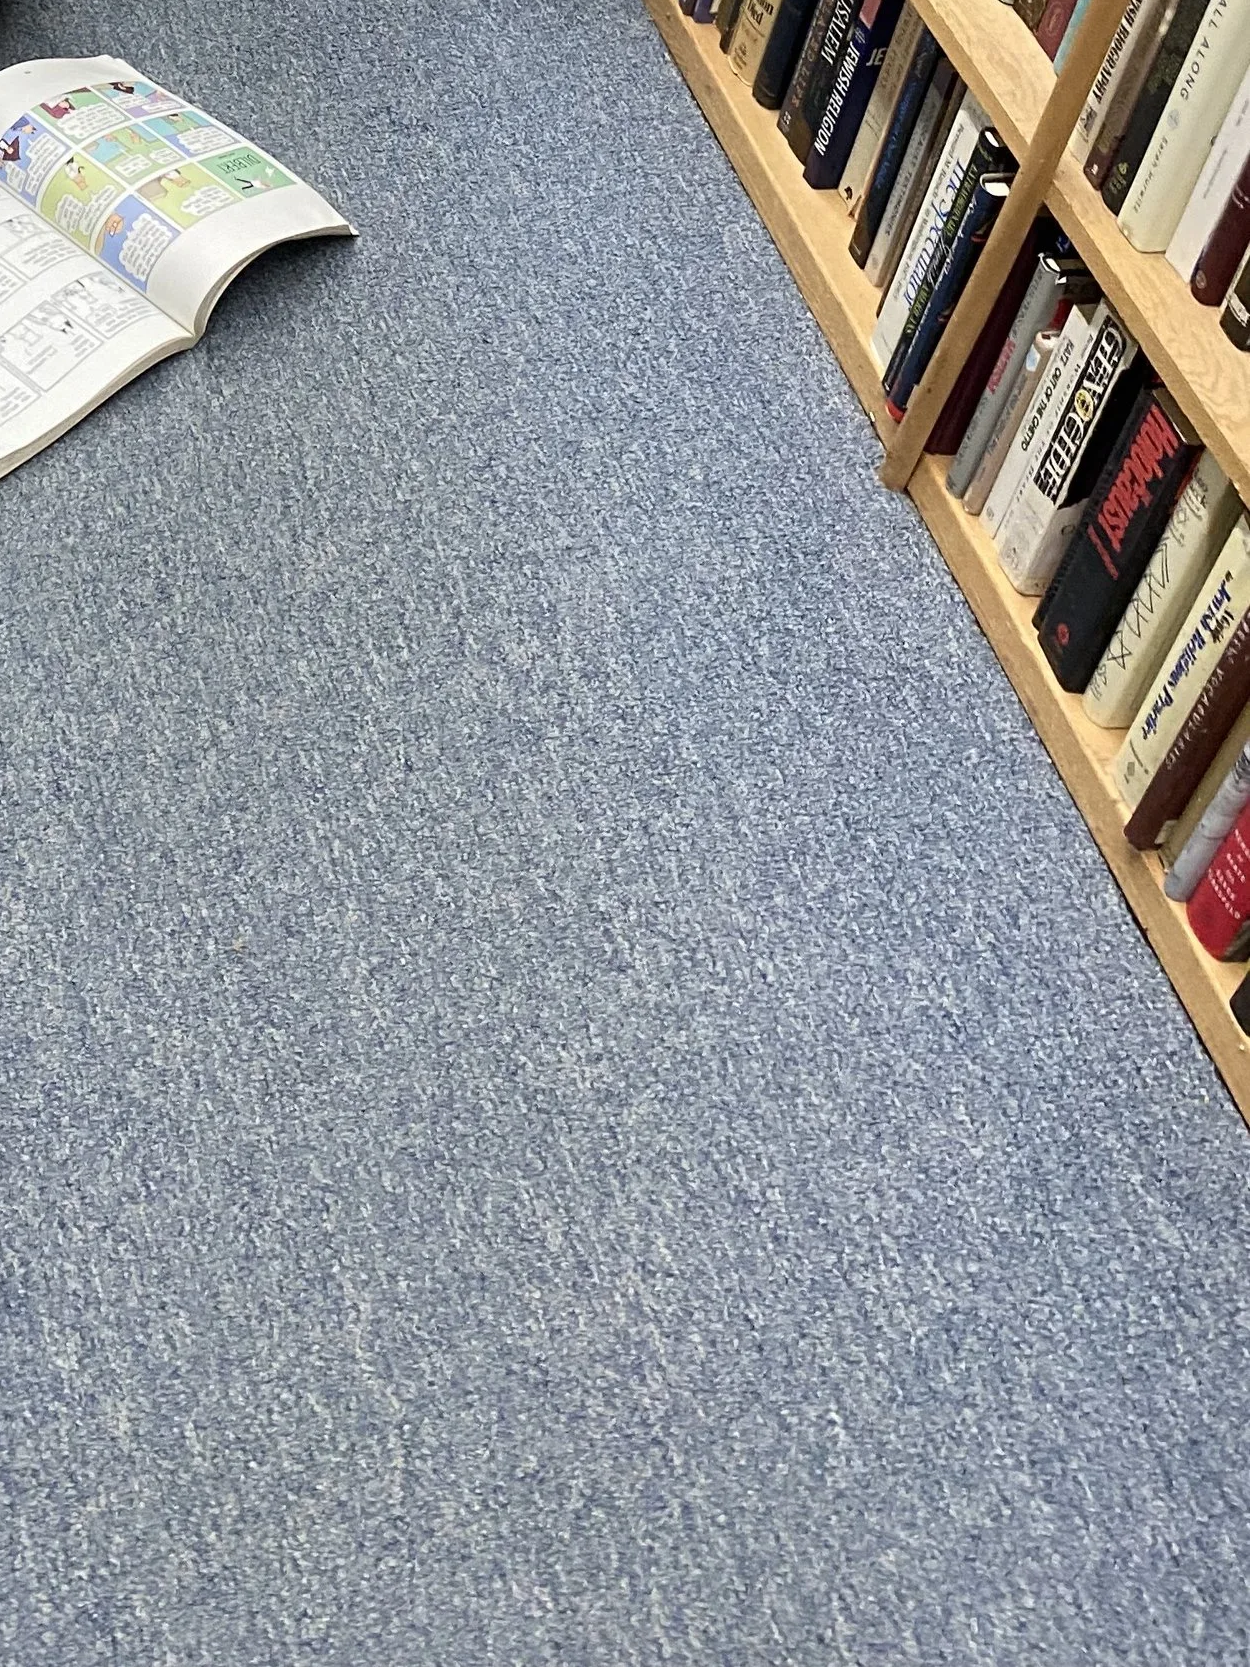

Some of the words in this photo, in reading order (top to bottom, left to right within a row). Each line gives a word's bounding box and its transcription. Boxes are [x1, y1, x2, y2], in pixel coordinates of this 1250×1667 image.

[834, 40, 860, 96] JEWISH
[1090, 23, 1127, 104] BIOGRAPHY
[1178, 34, 1211, 101] ALONG
[812, 88, 843, 157] RELIGION
[215, 153, 263, 175] DILBERT
[1048, 365, 1061, 390] OUT
[1060, 338, 1074, 367] KATZ
[1019, 414, 1039, 453] GHETTO
[1036, 398, 1046, 417] THE
[1040, 324, 1123, 498] GENOCIDE
[1201, 579, 1232, 633] Jewish
[1169, 626, 1206, 693] Religious
[1140, 683, 1174, 743] Practice
